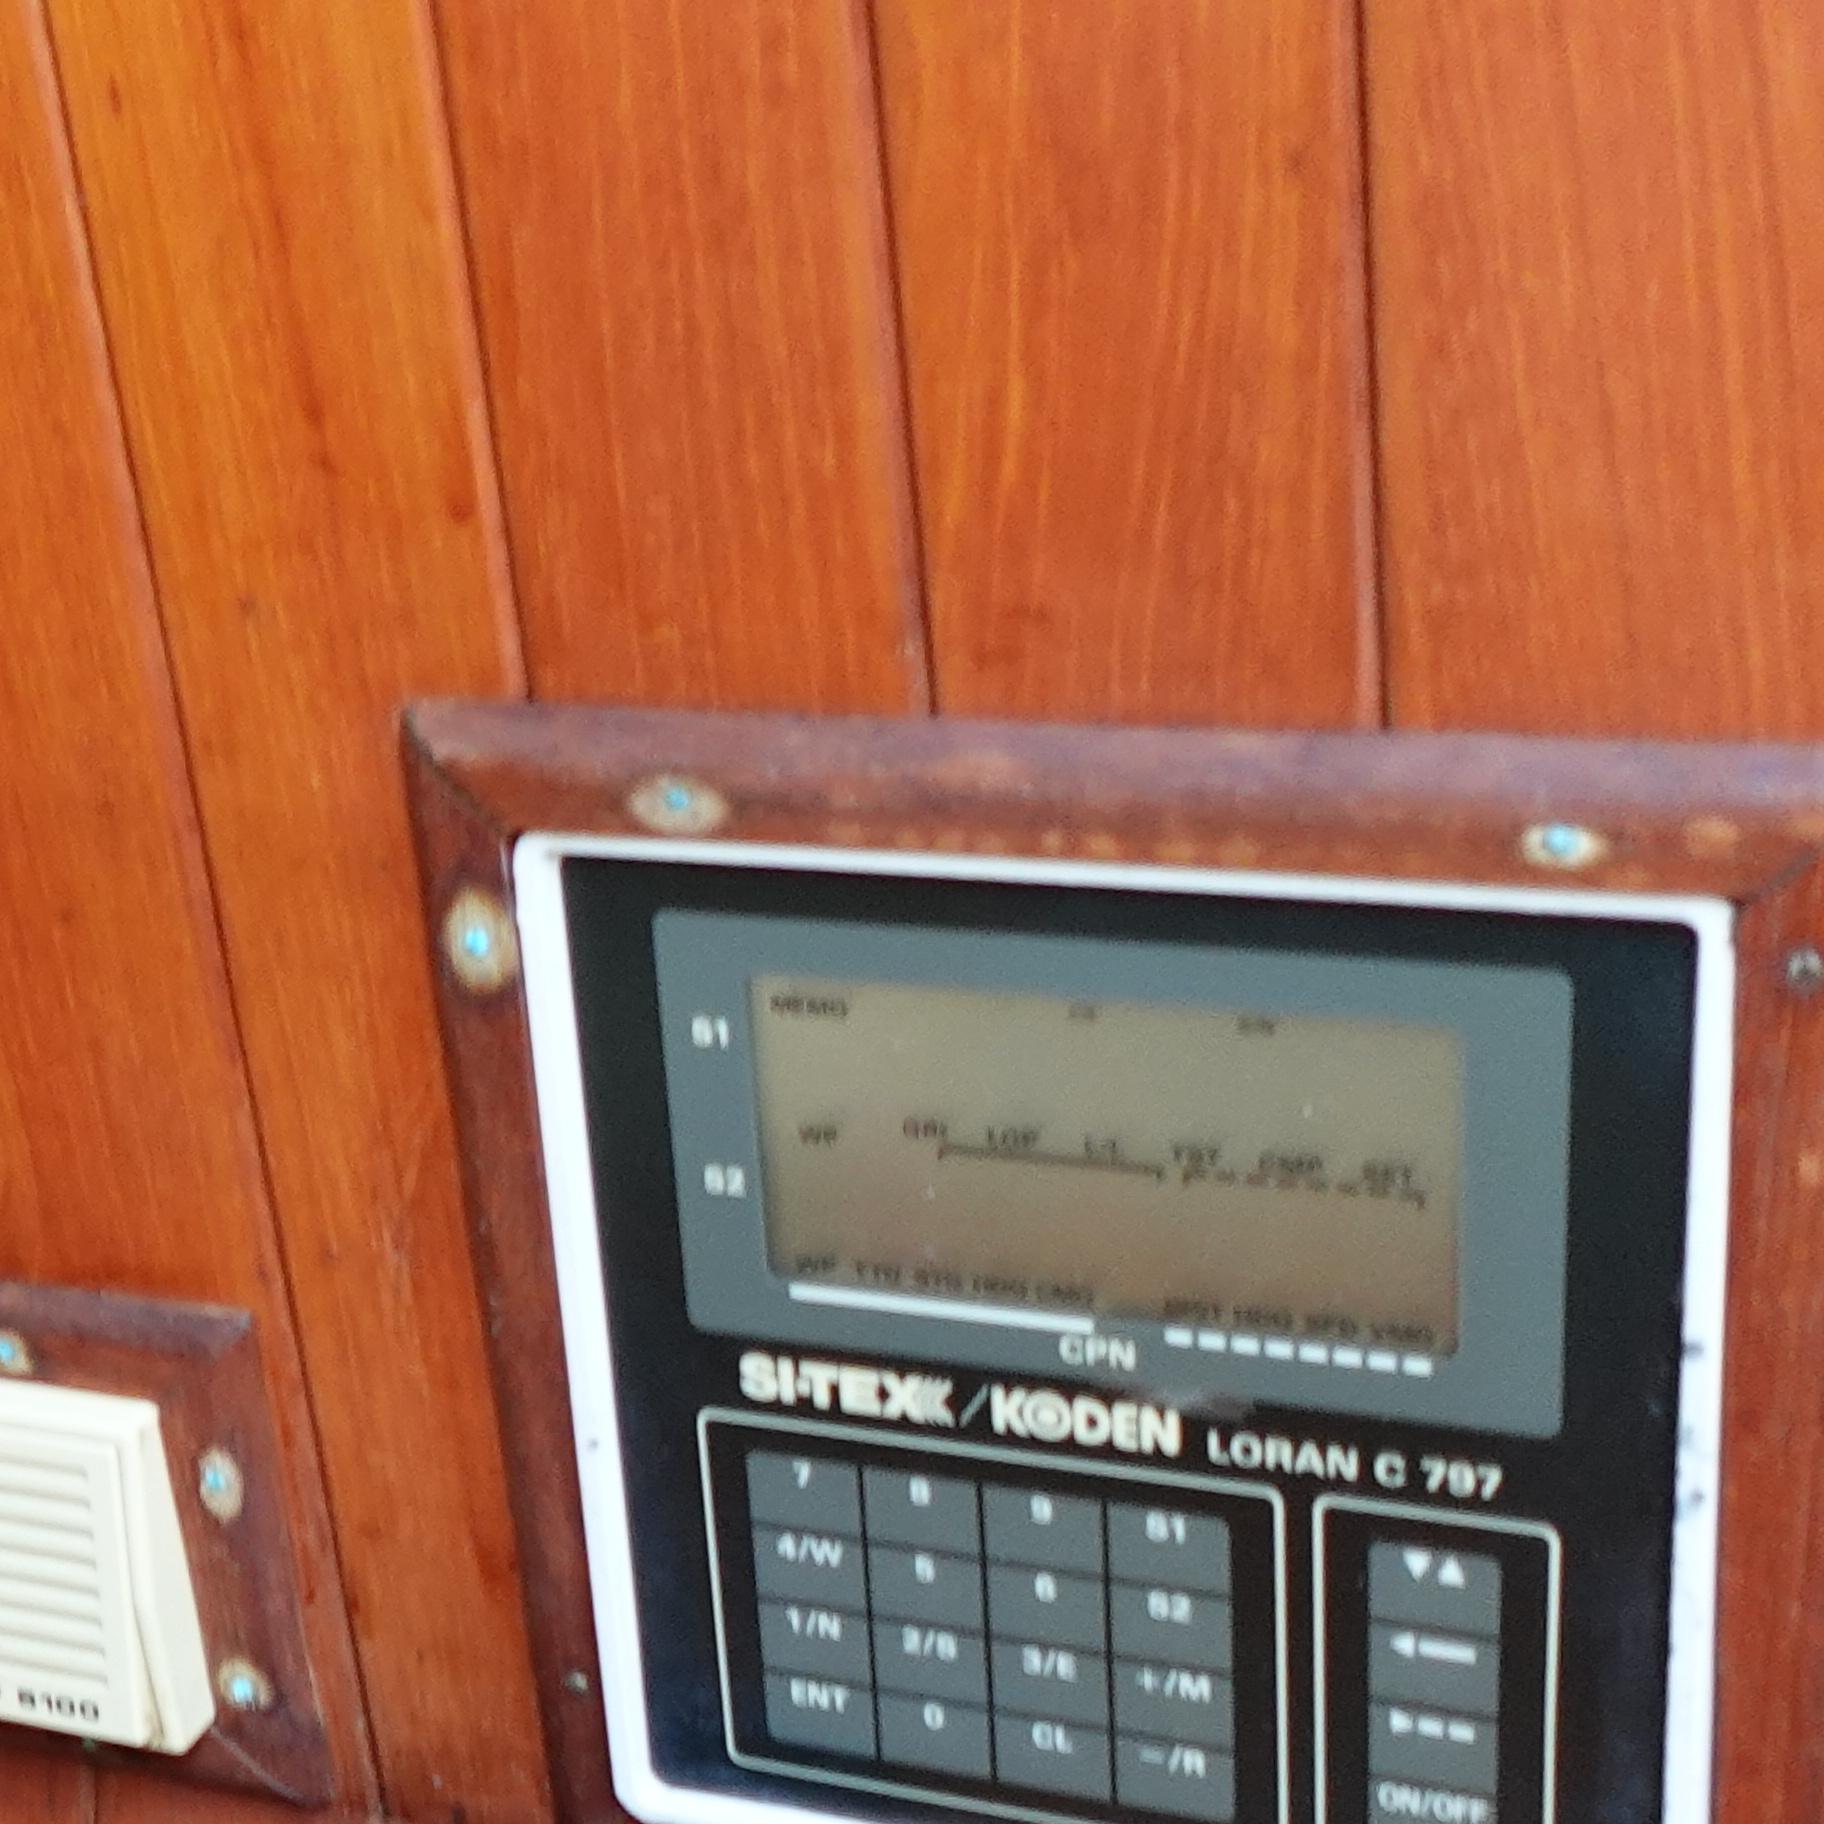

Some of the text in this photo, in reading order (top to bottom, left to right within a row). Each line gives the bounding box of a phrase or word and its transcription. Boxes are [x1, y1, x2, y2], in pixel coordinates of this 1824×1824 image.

[692, 1015, 729, 1049] S1
[704, 1163, 746, 1198] S2
[792, 1459, 813, 1490] 7
[1207, 1427, 1360, 1483] LORAN
[1372, 1450, 1409, 1490] C
[1145, 1508, 1187, 1545] S1
[775, 1531, 844, 1568] 4/W
[785, 1605, 843, 1642] 1/N
[1146, 1588, 1193, 1625] S2
[900, 1623, 959, 1662] 2/S
[1022, 1643, 1079, 1683] 3/E
[790, 1677, 851, 1714] ENT
[1031, 1720, 1072, 1755] CL
